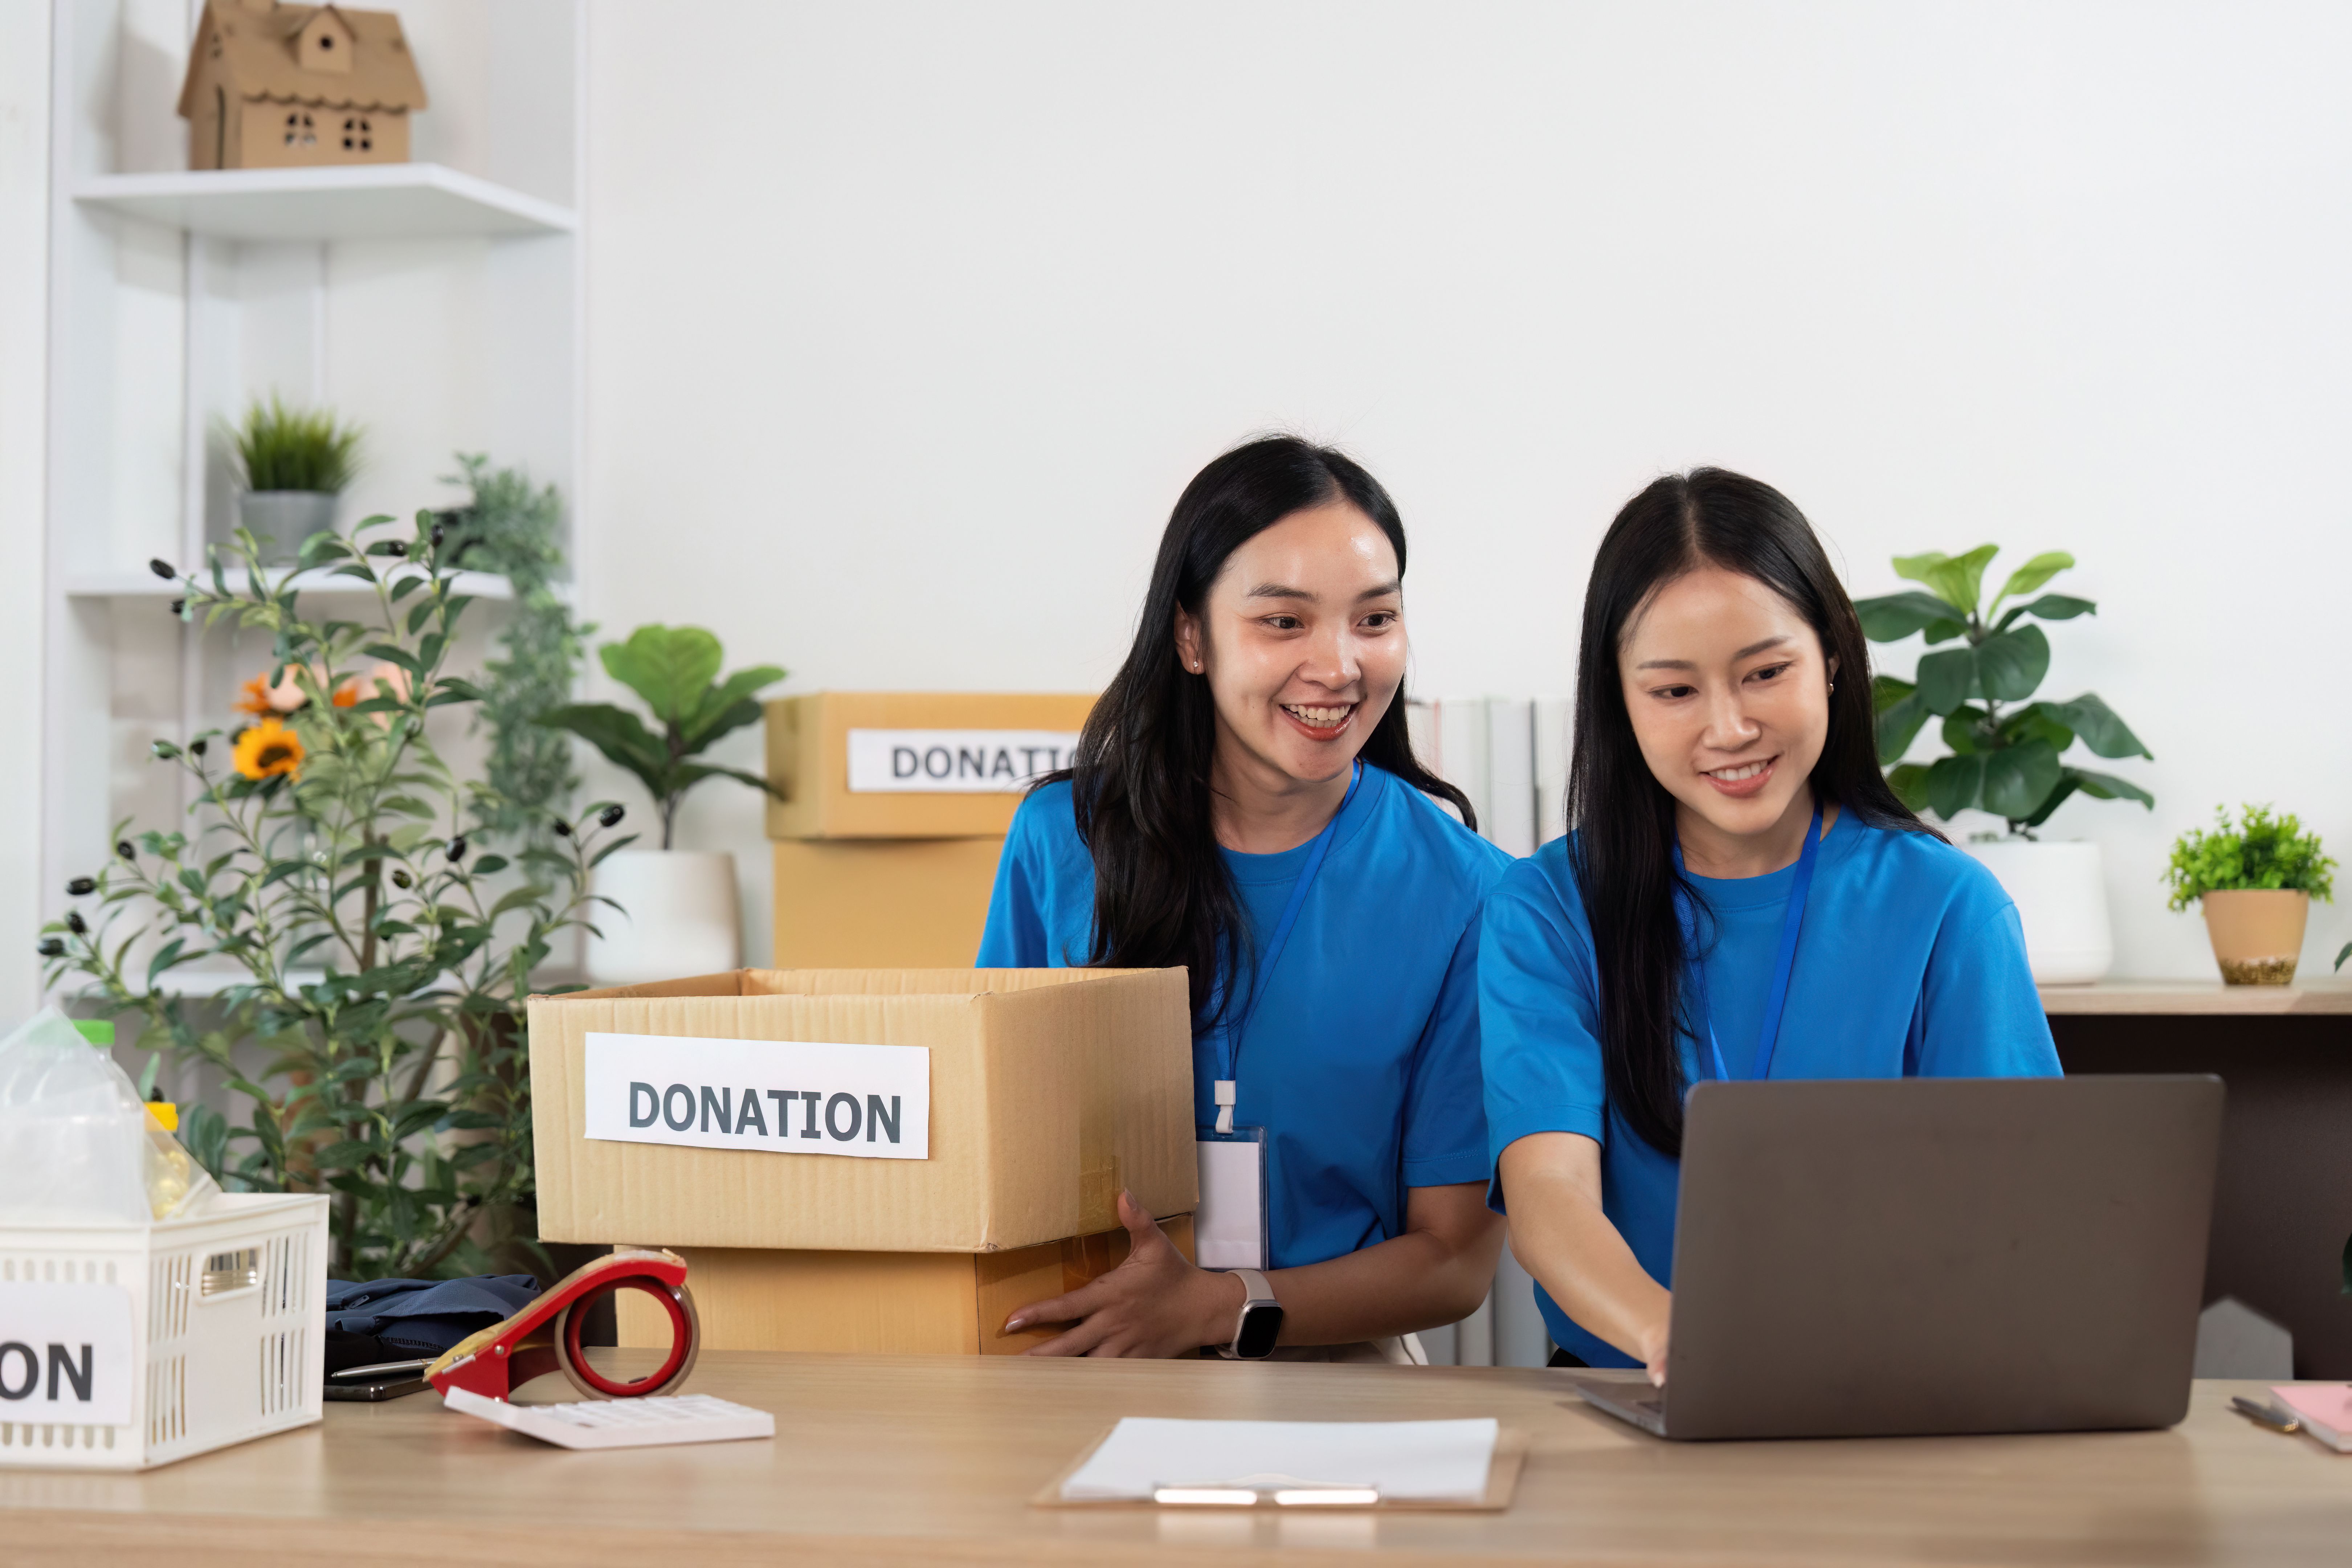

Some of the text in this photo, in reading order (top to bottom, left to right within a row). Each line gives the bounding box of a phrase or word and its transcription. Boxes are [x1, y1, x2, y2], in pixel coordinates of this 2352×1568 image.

[893, 746, 1074, 779] DONATI
[629, 1082, 901, 1144] DONATION
[0, 1342, 92, 1401] ON
